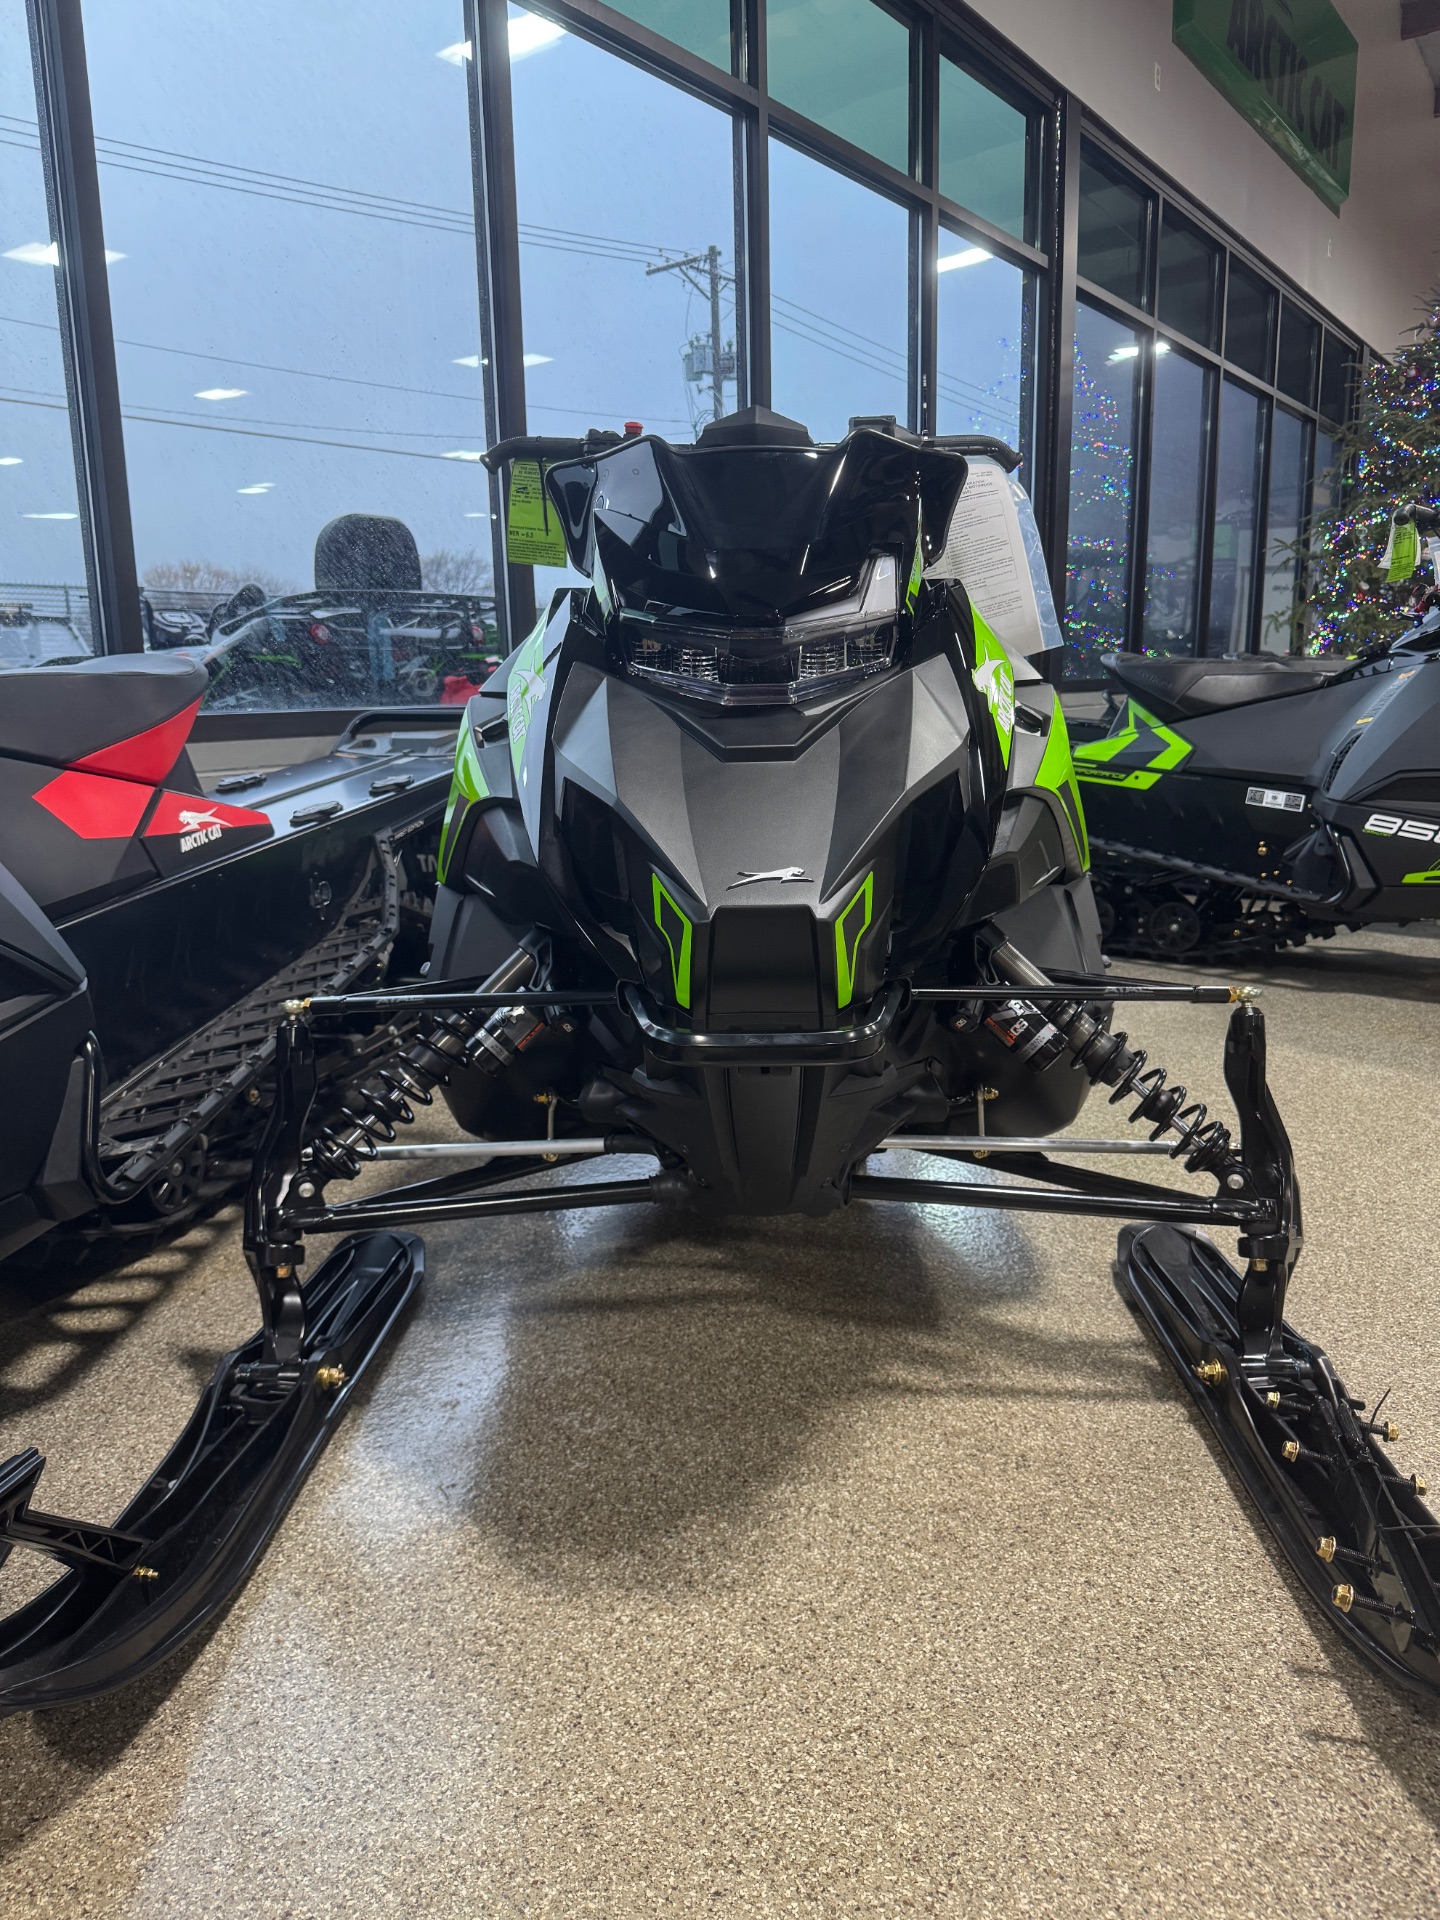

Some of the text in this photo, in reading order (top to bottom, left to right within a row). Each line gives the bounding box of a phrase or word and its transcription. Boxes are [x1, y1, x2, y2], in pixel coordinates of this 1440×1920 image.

[1226, 0, 1347, 171] ARCTIC CAT
[180, 824, 222, 853] ARCTIC CAT
[1364, 813, 1440, 843] 85
